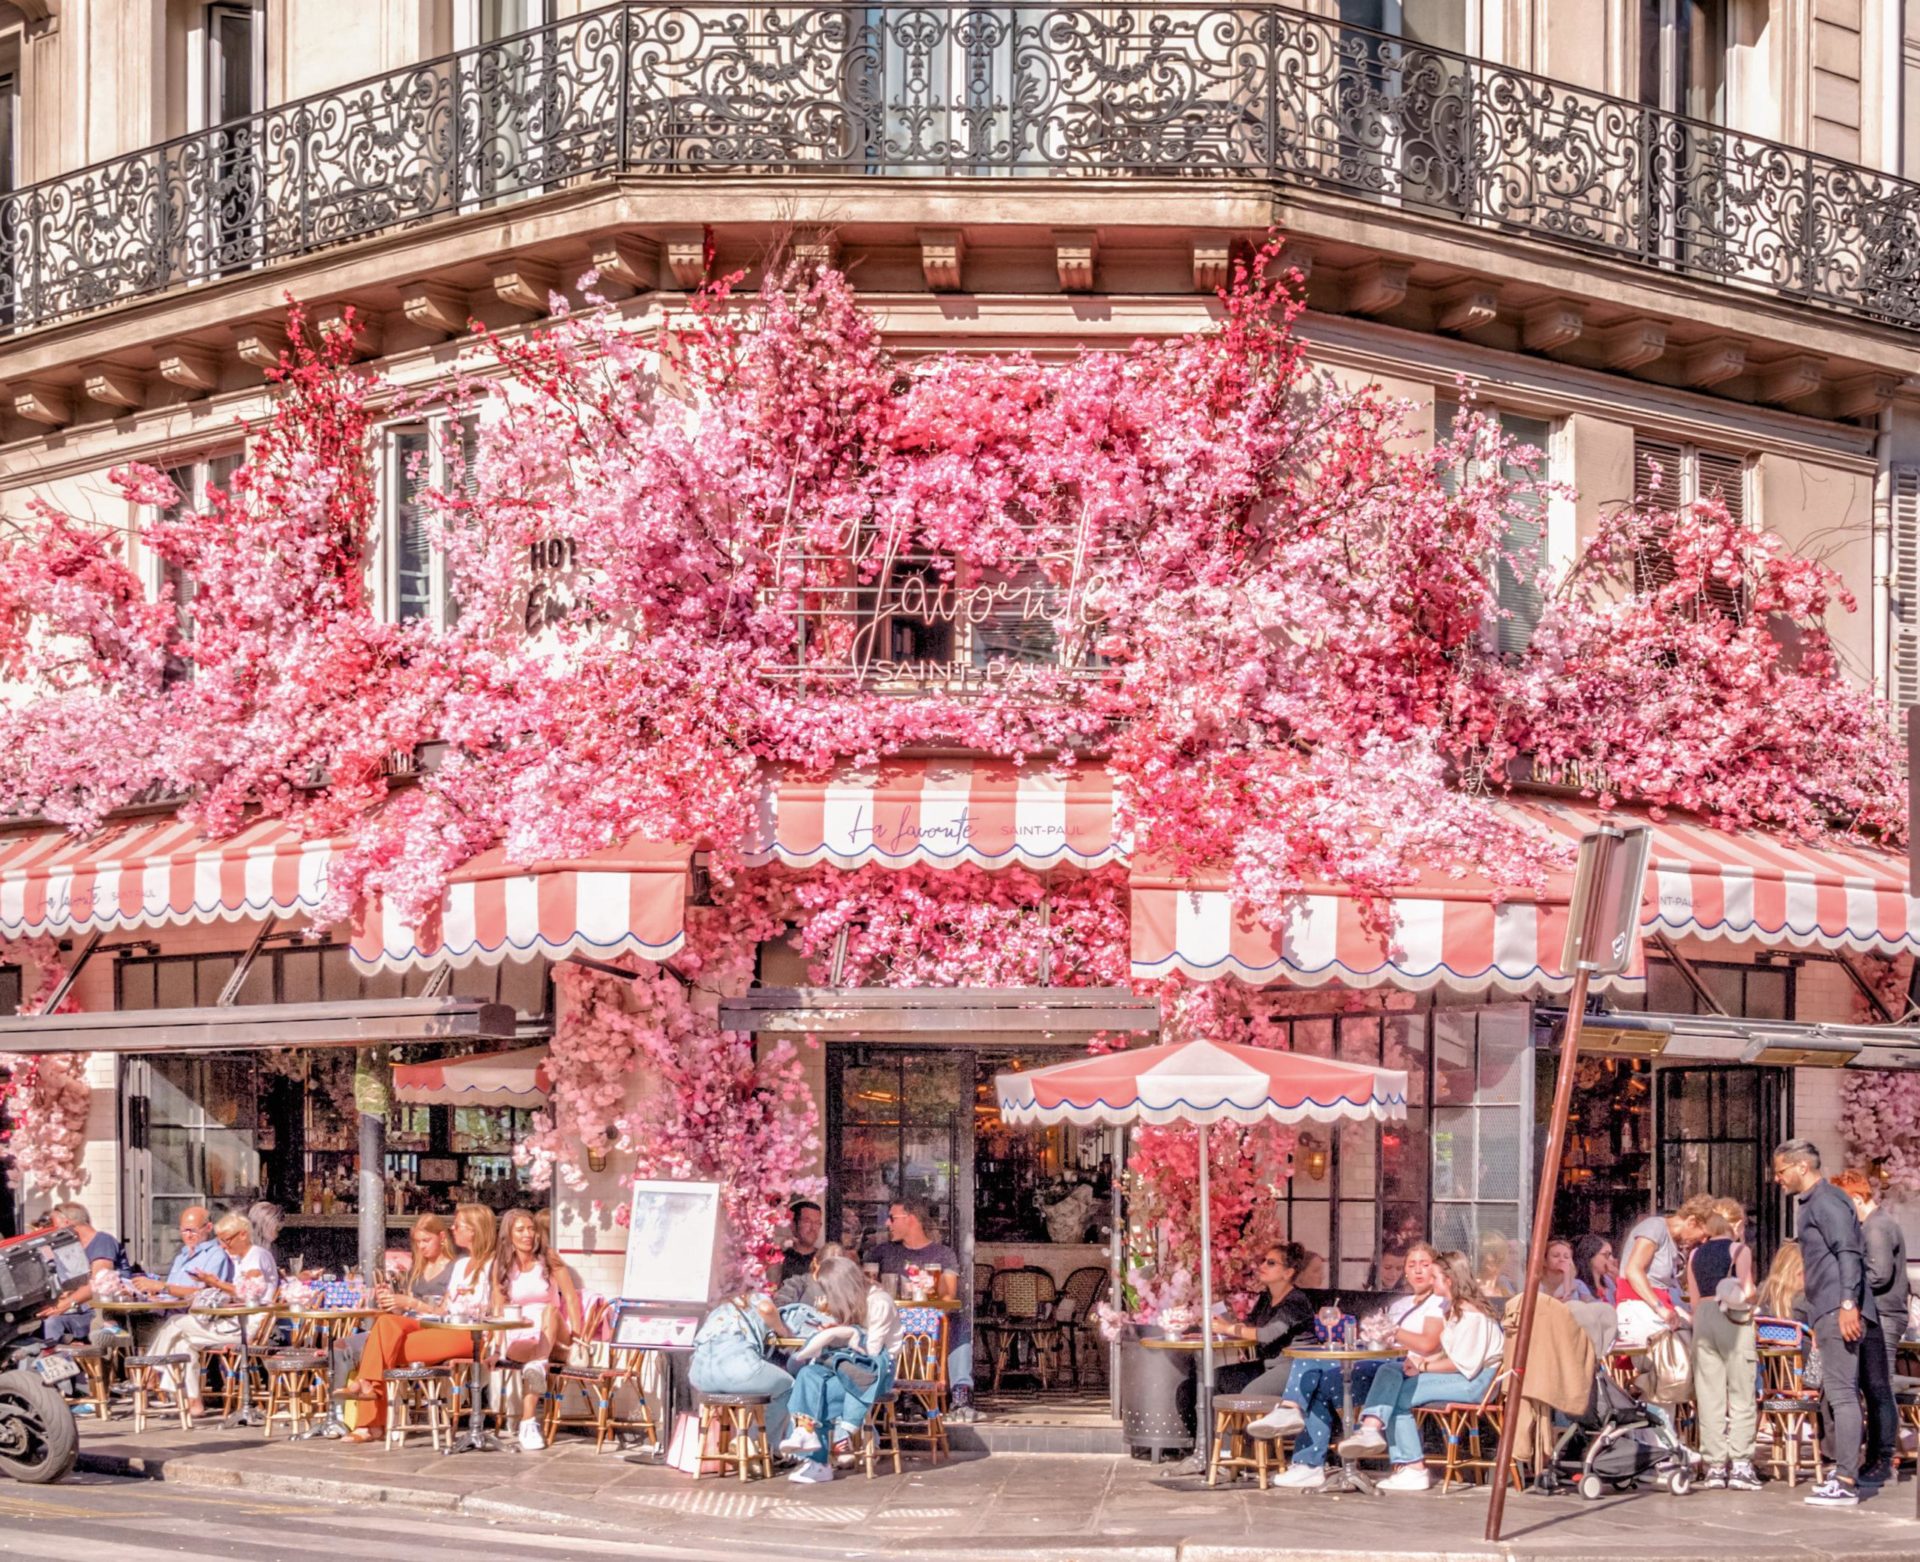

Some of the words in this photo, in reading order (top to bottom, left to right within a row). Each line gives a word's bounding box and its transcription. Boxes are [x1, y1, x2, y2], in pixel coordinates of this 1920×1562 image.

[848, 805, 888, 844] La
[896, 805, 980, 852] favorite
[1000, 825, 1085, 836] SAINT-PAUL
